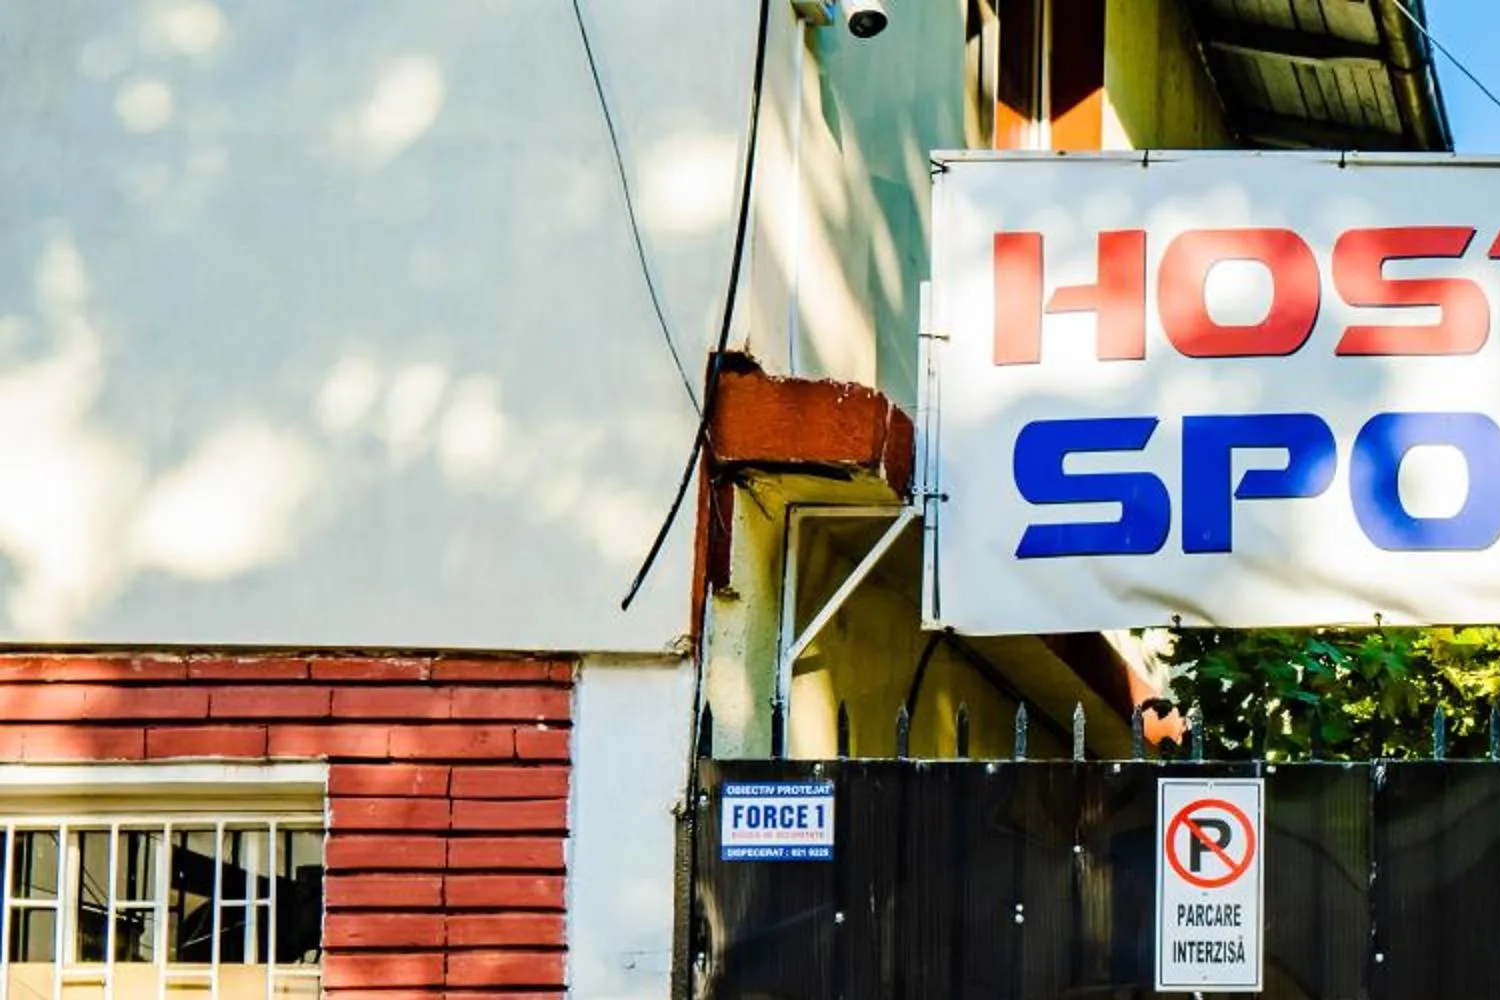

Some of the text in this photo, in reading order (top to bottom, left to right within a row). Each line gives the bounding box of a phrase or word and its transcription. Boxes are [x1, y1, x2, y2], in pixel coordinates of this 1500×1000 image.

[777, 785, 830, 795] PROTEJAT
[732, 804, 825, 829] FORCE 1
[1176, 904, 1241, 927] PARCARE
